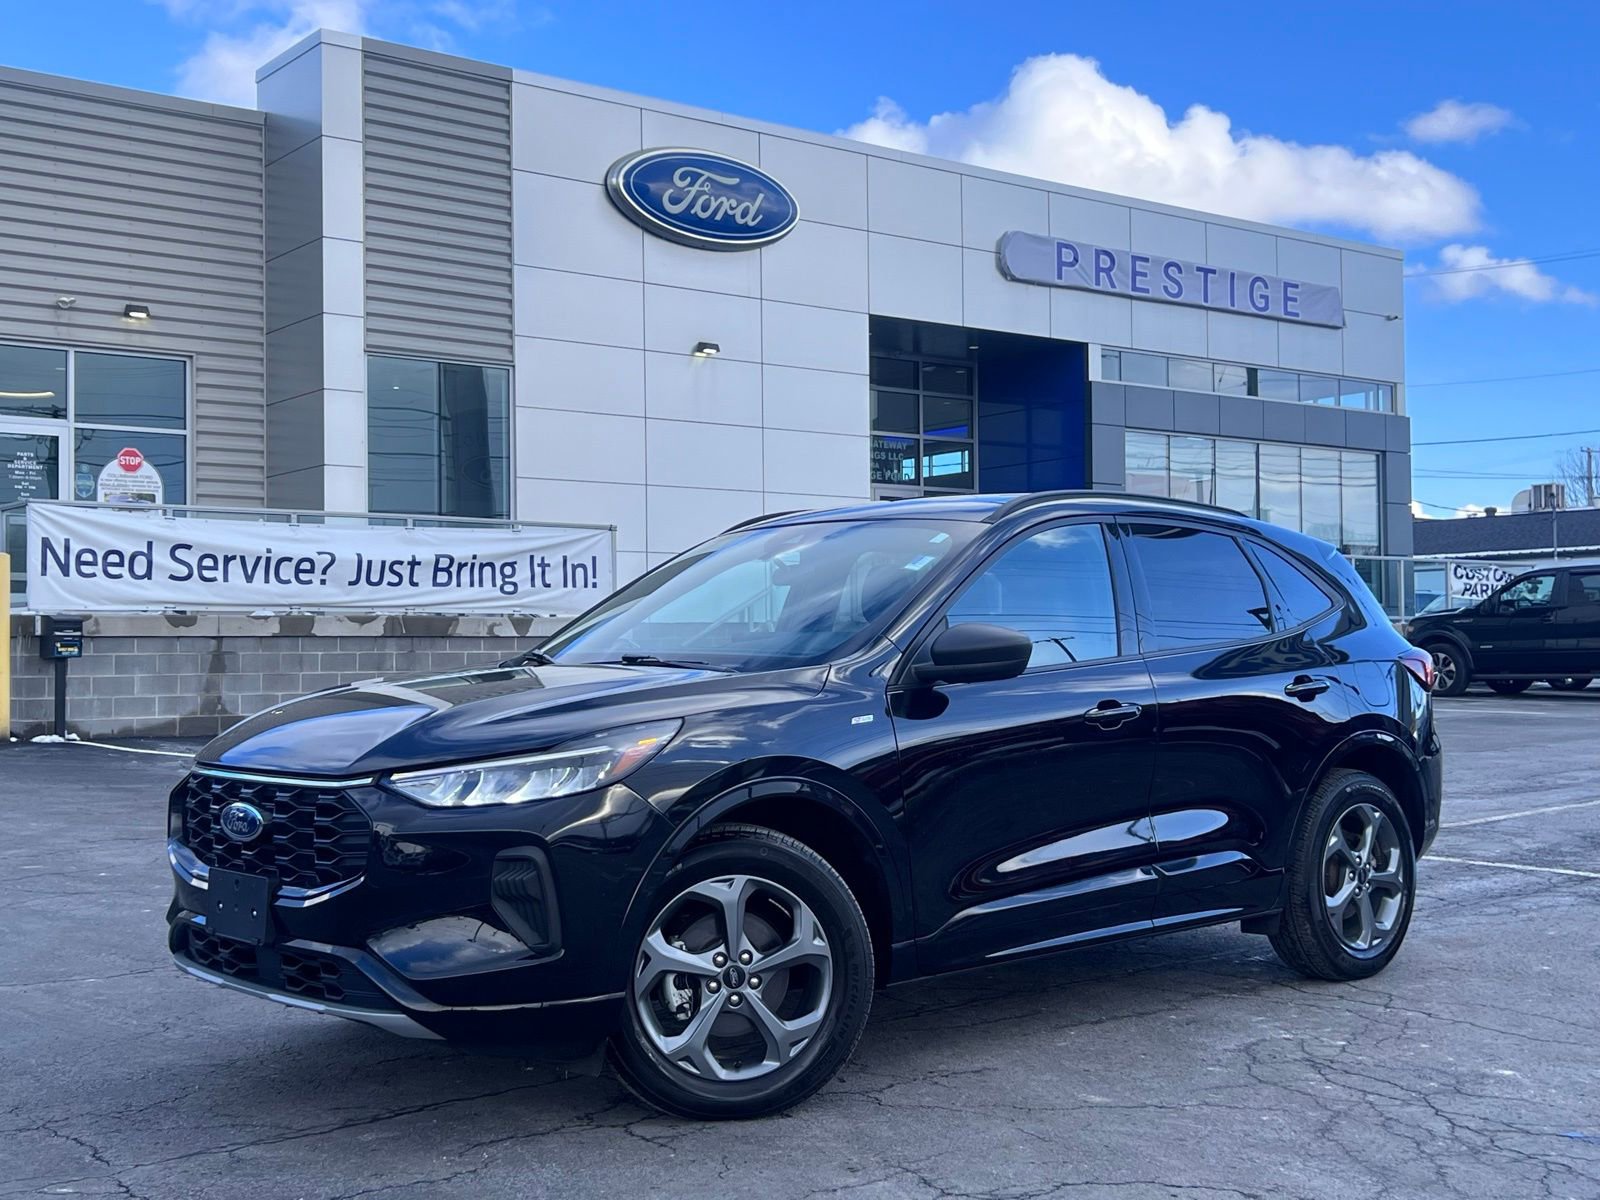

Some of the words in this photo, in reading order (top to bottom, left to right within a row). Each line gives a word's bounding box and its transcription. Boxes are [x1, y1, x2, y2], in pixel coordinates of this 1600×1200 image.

[662, 166, 765, 227] Ford
[1056, 241, 1300, 318] PRESTIGE
[120, 456, 141, 465] STOP
[871, 439, 907, 450] ATEWAY
[888, 451, 904, 461] LLC
[40, 536, 153, 581] Need
[168, 543, 337, 586] Service?
[348, 552, 421, 588] Just
[431, 554, 519, 595] Bring
[529, 554, 551, 588] It
[562, 555, 598, 588] In!
